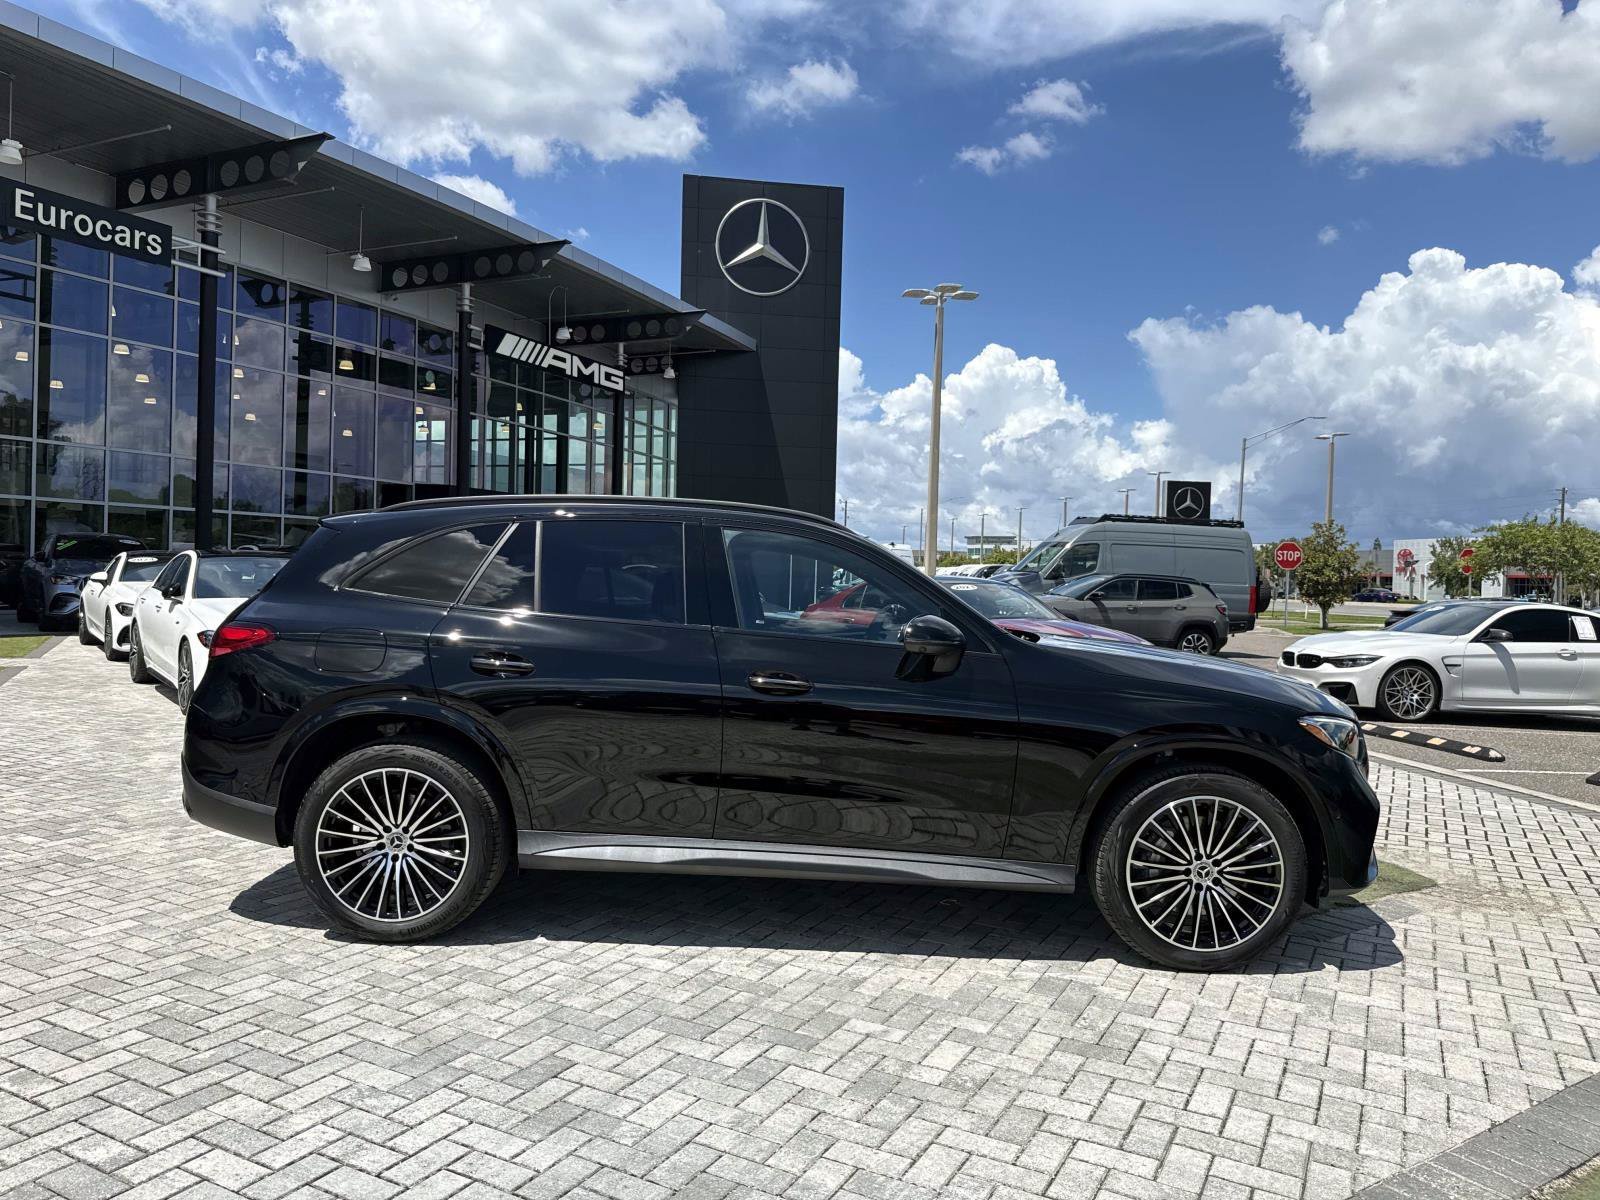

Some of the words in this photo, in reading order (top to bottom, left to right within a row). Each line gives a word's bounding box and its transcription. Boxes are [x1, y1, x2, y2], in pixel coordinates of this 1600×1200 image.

[14, 188, 162, 256] Eurocars
[541, 347, 624, 392] AMG
[1277, 550, 1301, 561] STOP
